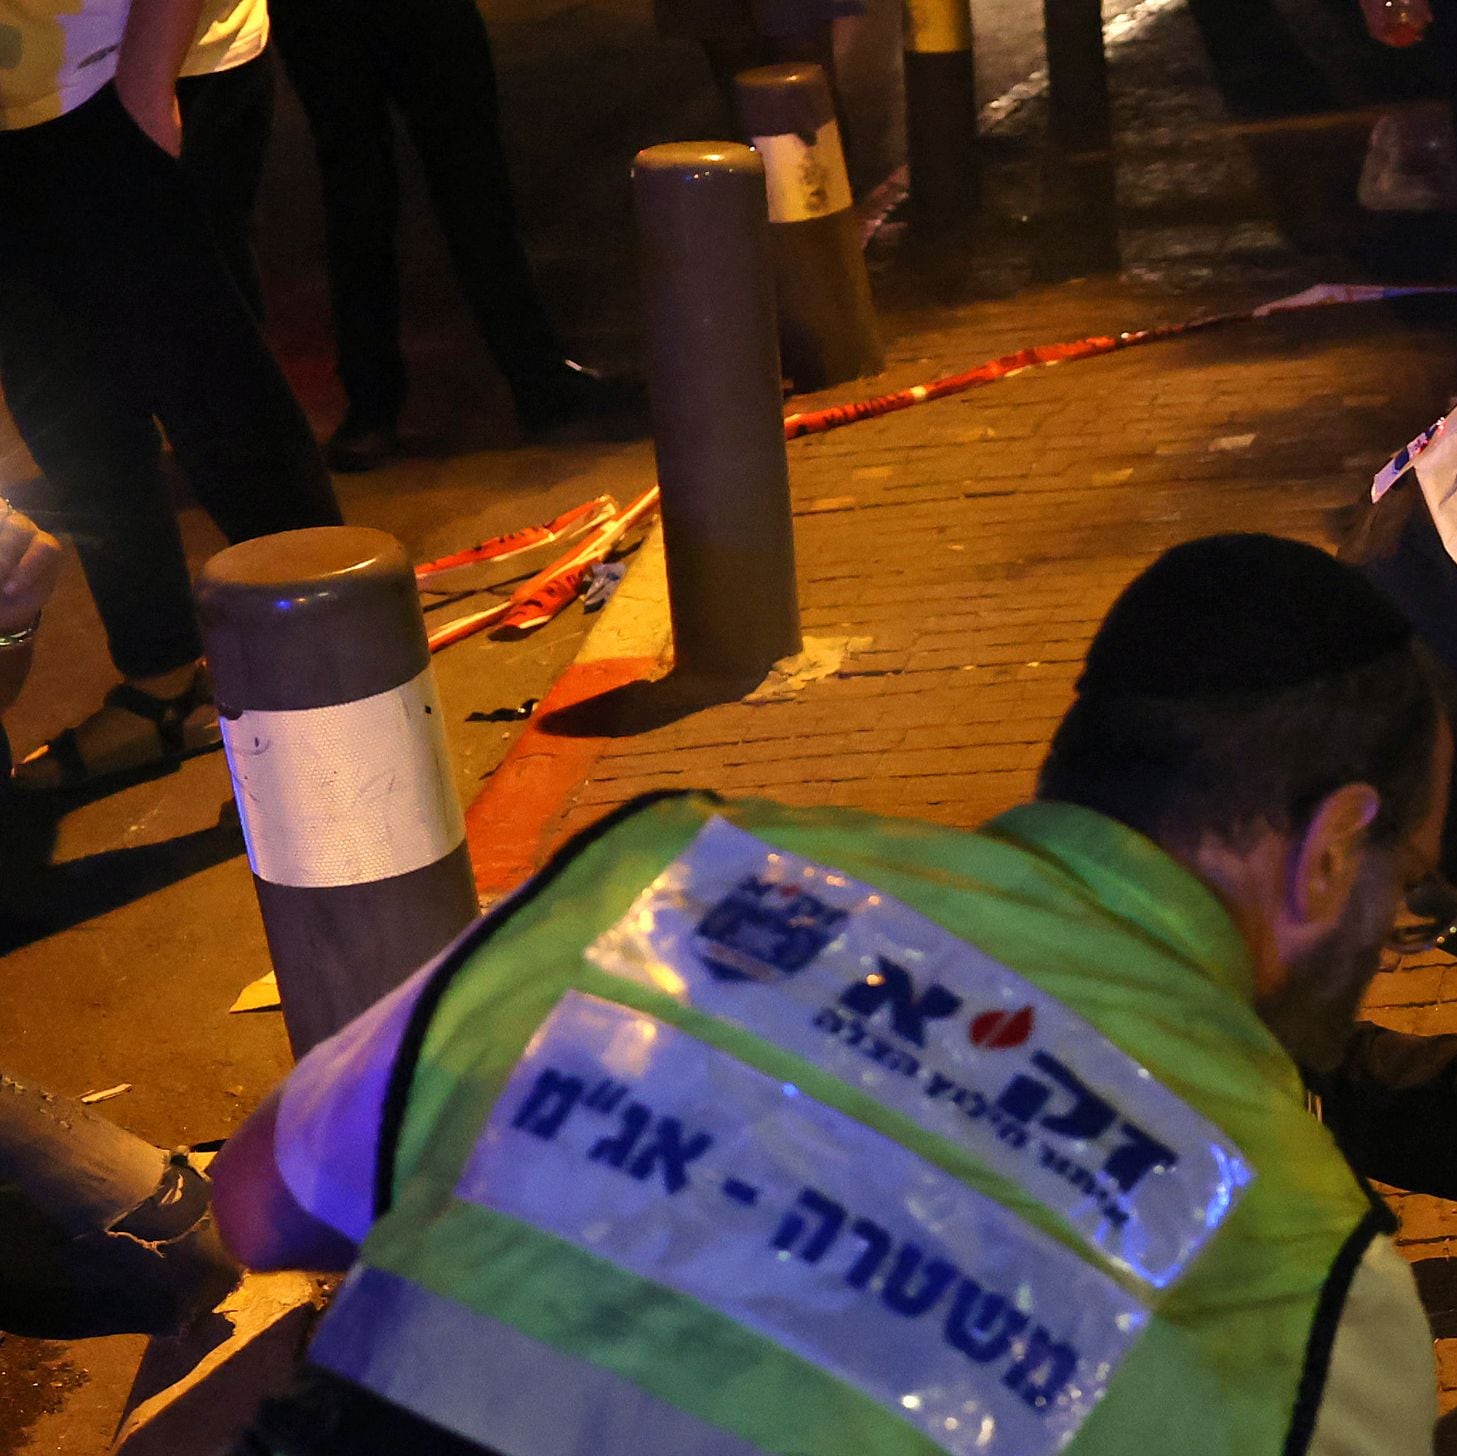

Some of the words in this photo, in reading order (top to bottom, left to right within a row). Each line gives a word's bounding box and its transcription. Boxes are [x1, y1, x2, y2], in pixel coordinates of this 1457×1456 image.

[923, 1070, 1029, 1149] חילוץ
[1040, 1143, 1131, 1230] איתור
[771, 1185, 1079, 1412] משטרה
